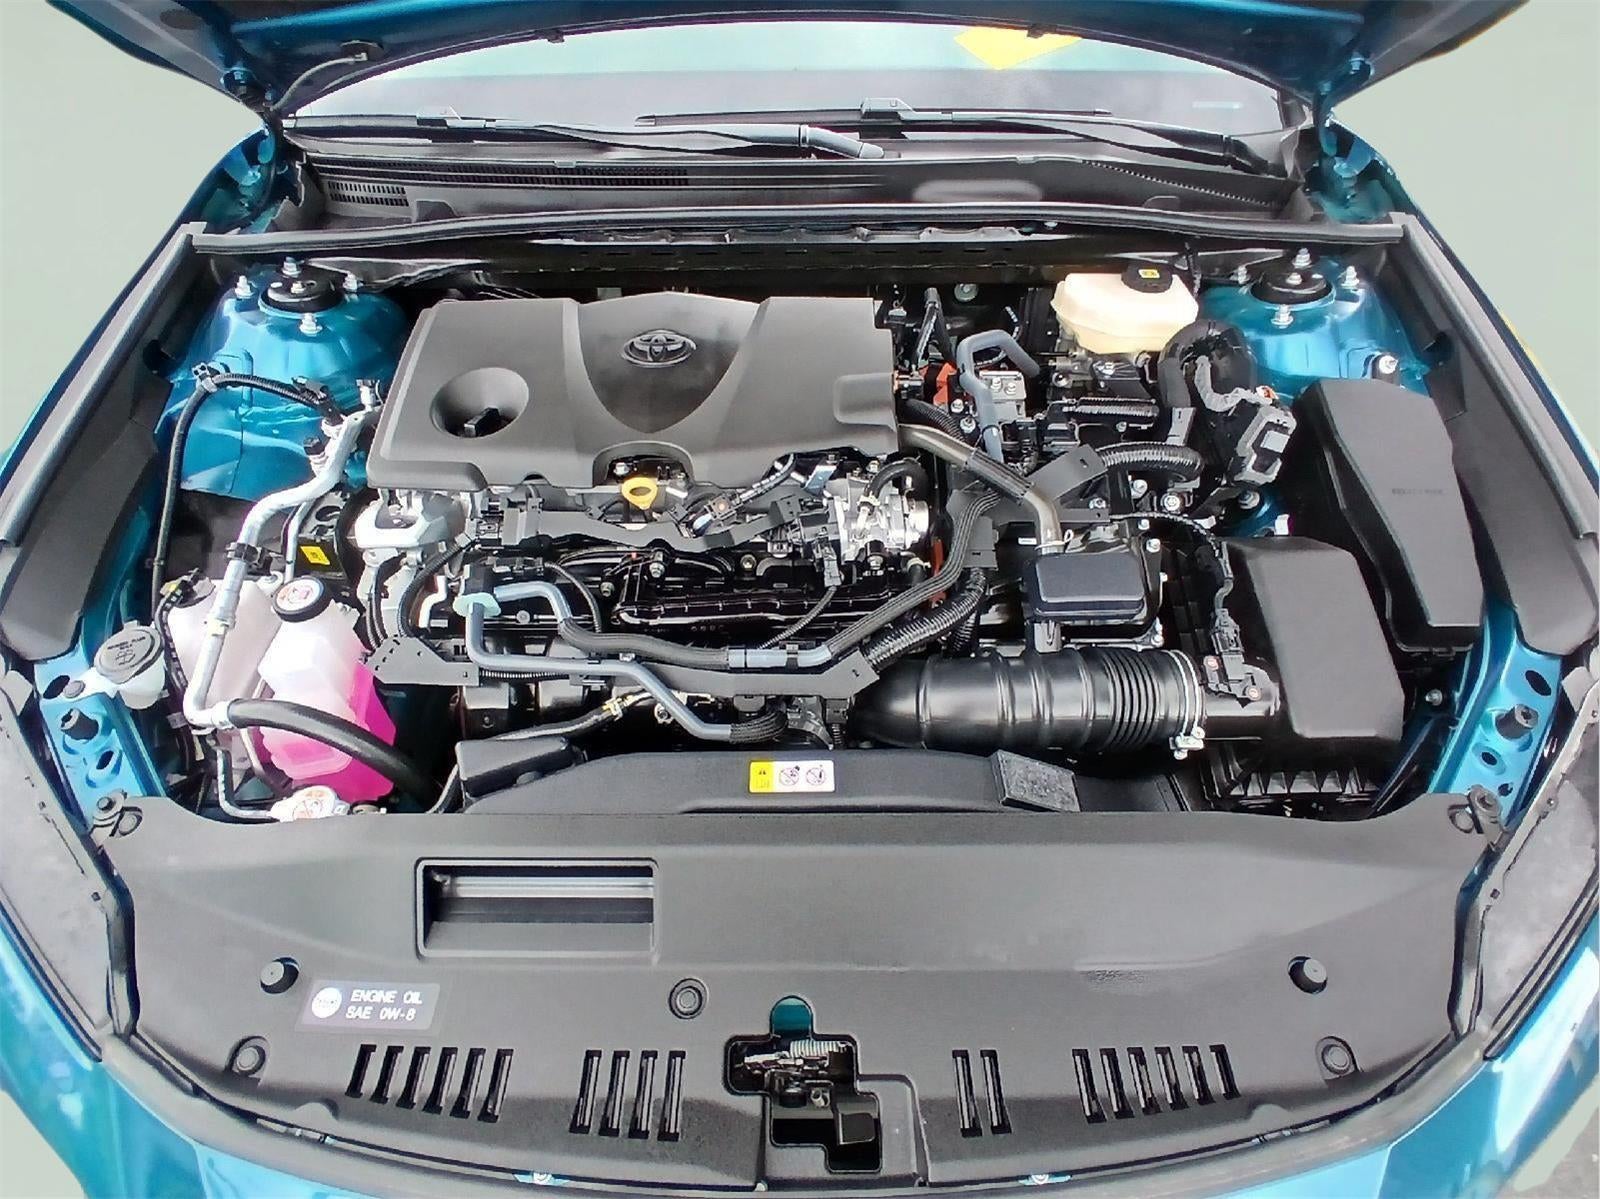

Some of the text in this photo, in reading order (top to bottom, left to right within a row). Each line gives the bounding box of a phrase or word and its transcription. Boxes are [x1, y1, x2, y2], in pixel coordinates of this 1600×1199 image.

[351, 989, 397, 1003] ENGINE
[403, 990, 423, 1004] OIL
[346, 1006, 416, 1021] SAE 0W-8
